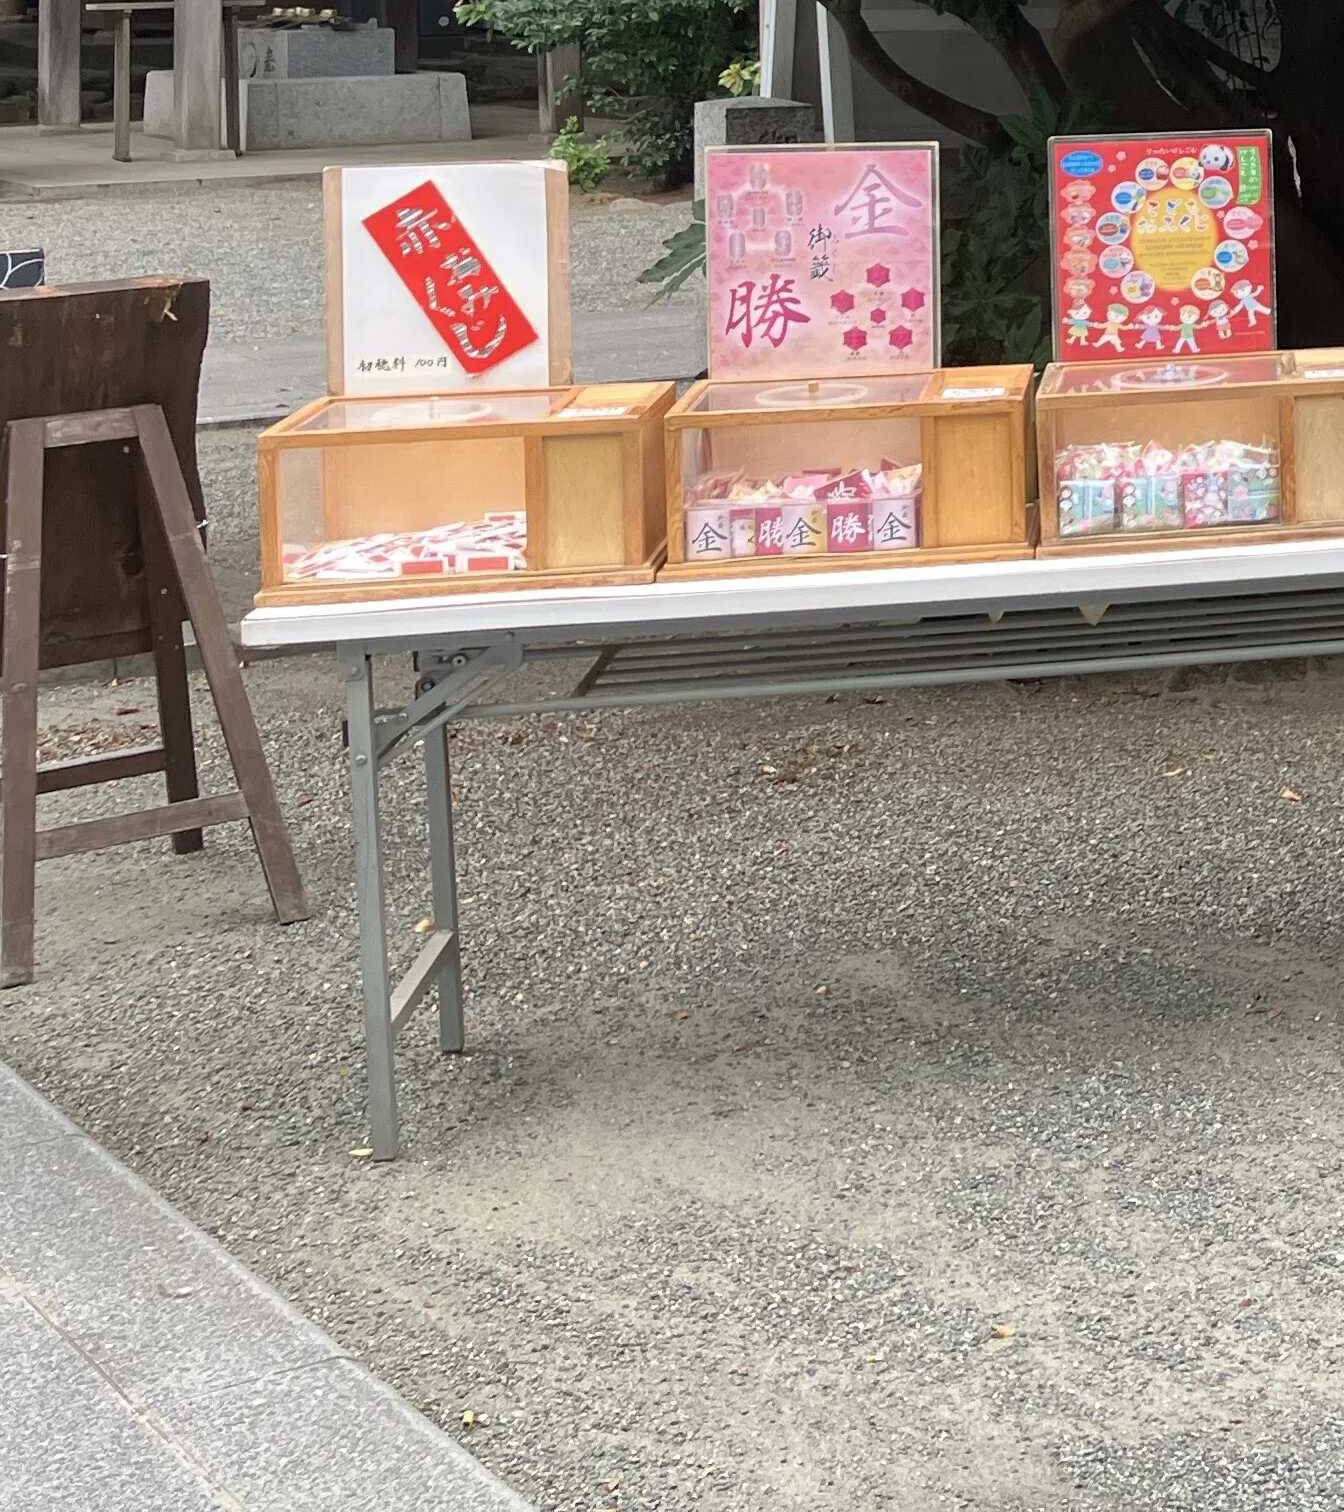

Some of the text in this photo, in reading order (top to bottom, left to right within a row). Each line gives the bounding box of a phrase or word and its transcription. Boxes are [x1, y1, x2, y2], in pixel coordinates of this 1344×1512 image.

[834, 164, 923, 239] 金
[725, 273, 811, 348] 勝
[414, 356, 448, 368] 100円
[692, 522, 728, 554] 金
[786, 517, 822, 548] 金
[831, 512, 865, 544] 勝
[877, 512, 912, 543] 金
